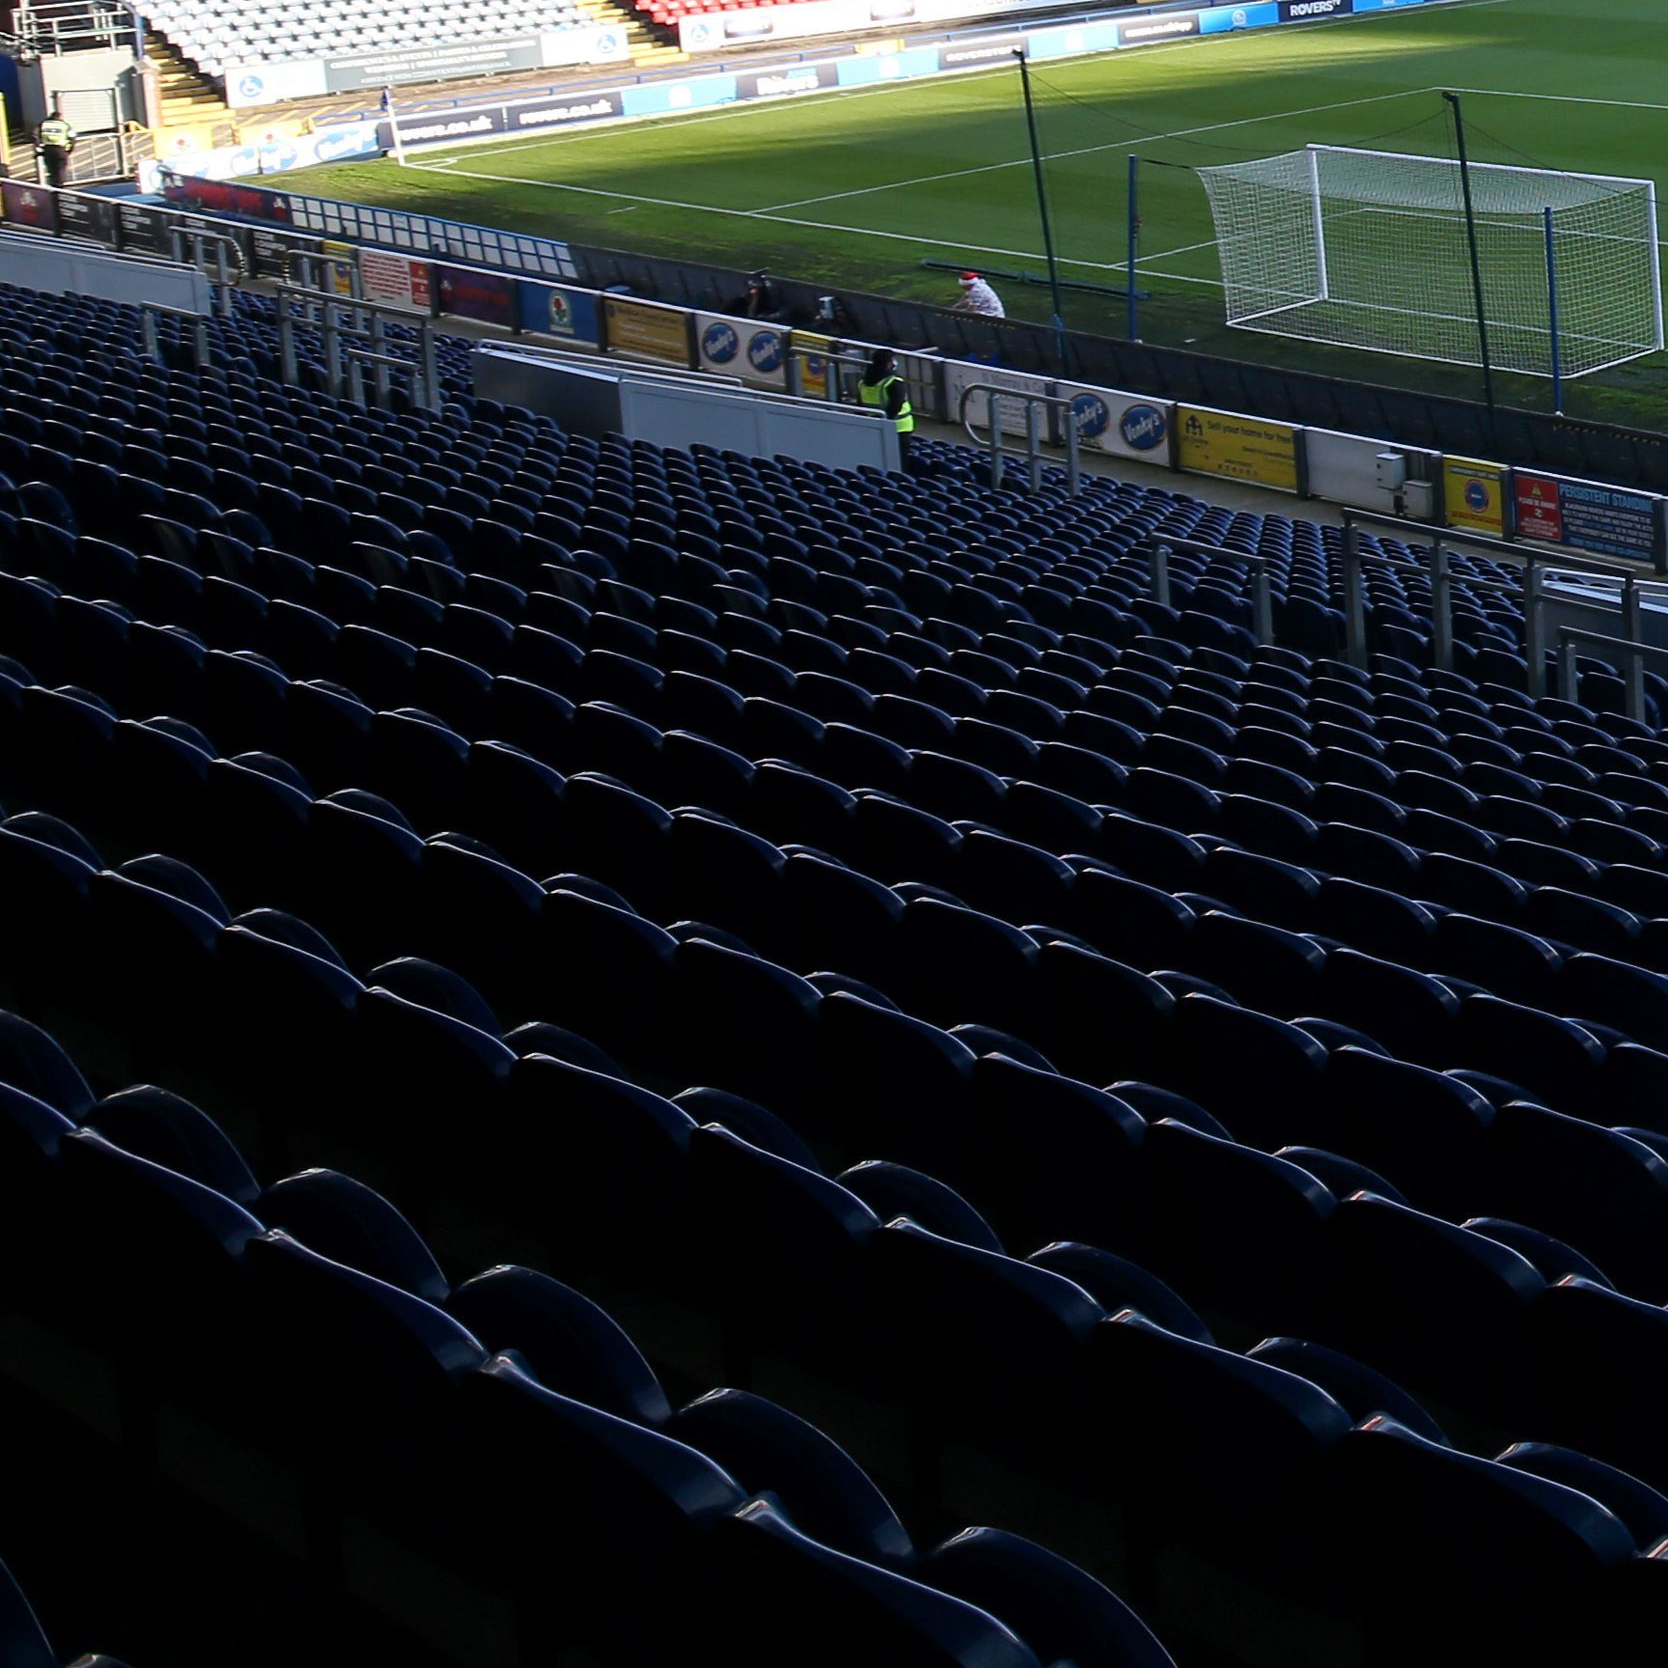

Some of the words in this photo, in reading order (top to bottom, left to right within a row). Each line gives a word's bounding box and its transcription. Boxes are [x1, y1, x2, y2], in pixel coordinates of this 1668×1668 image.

[1122, 411, 1161, 442] Vanky's
[1241, 428, 1263, 439] home
[1264, 431, 1275, 441] for
[1559, 483, 1611, 505] PERSISTENT
